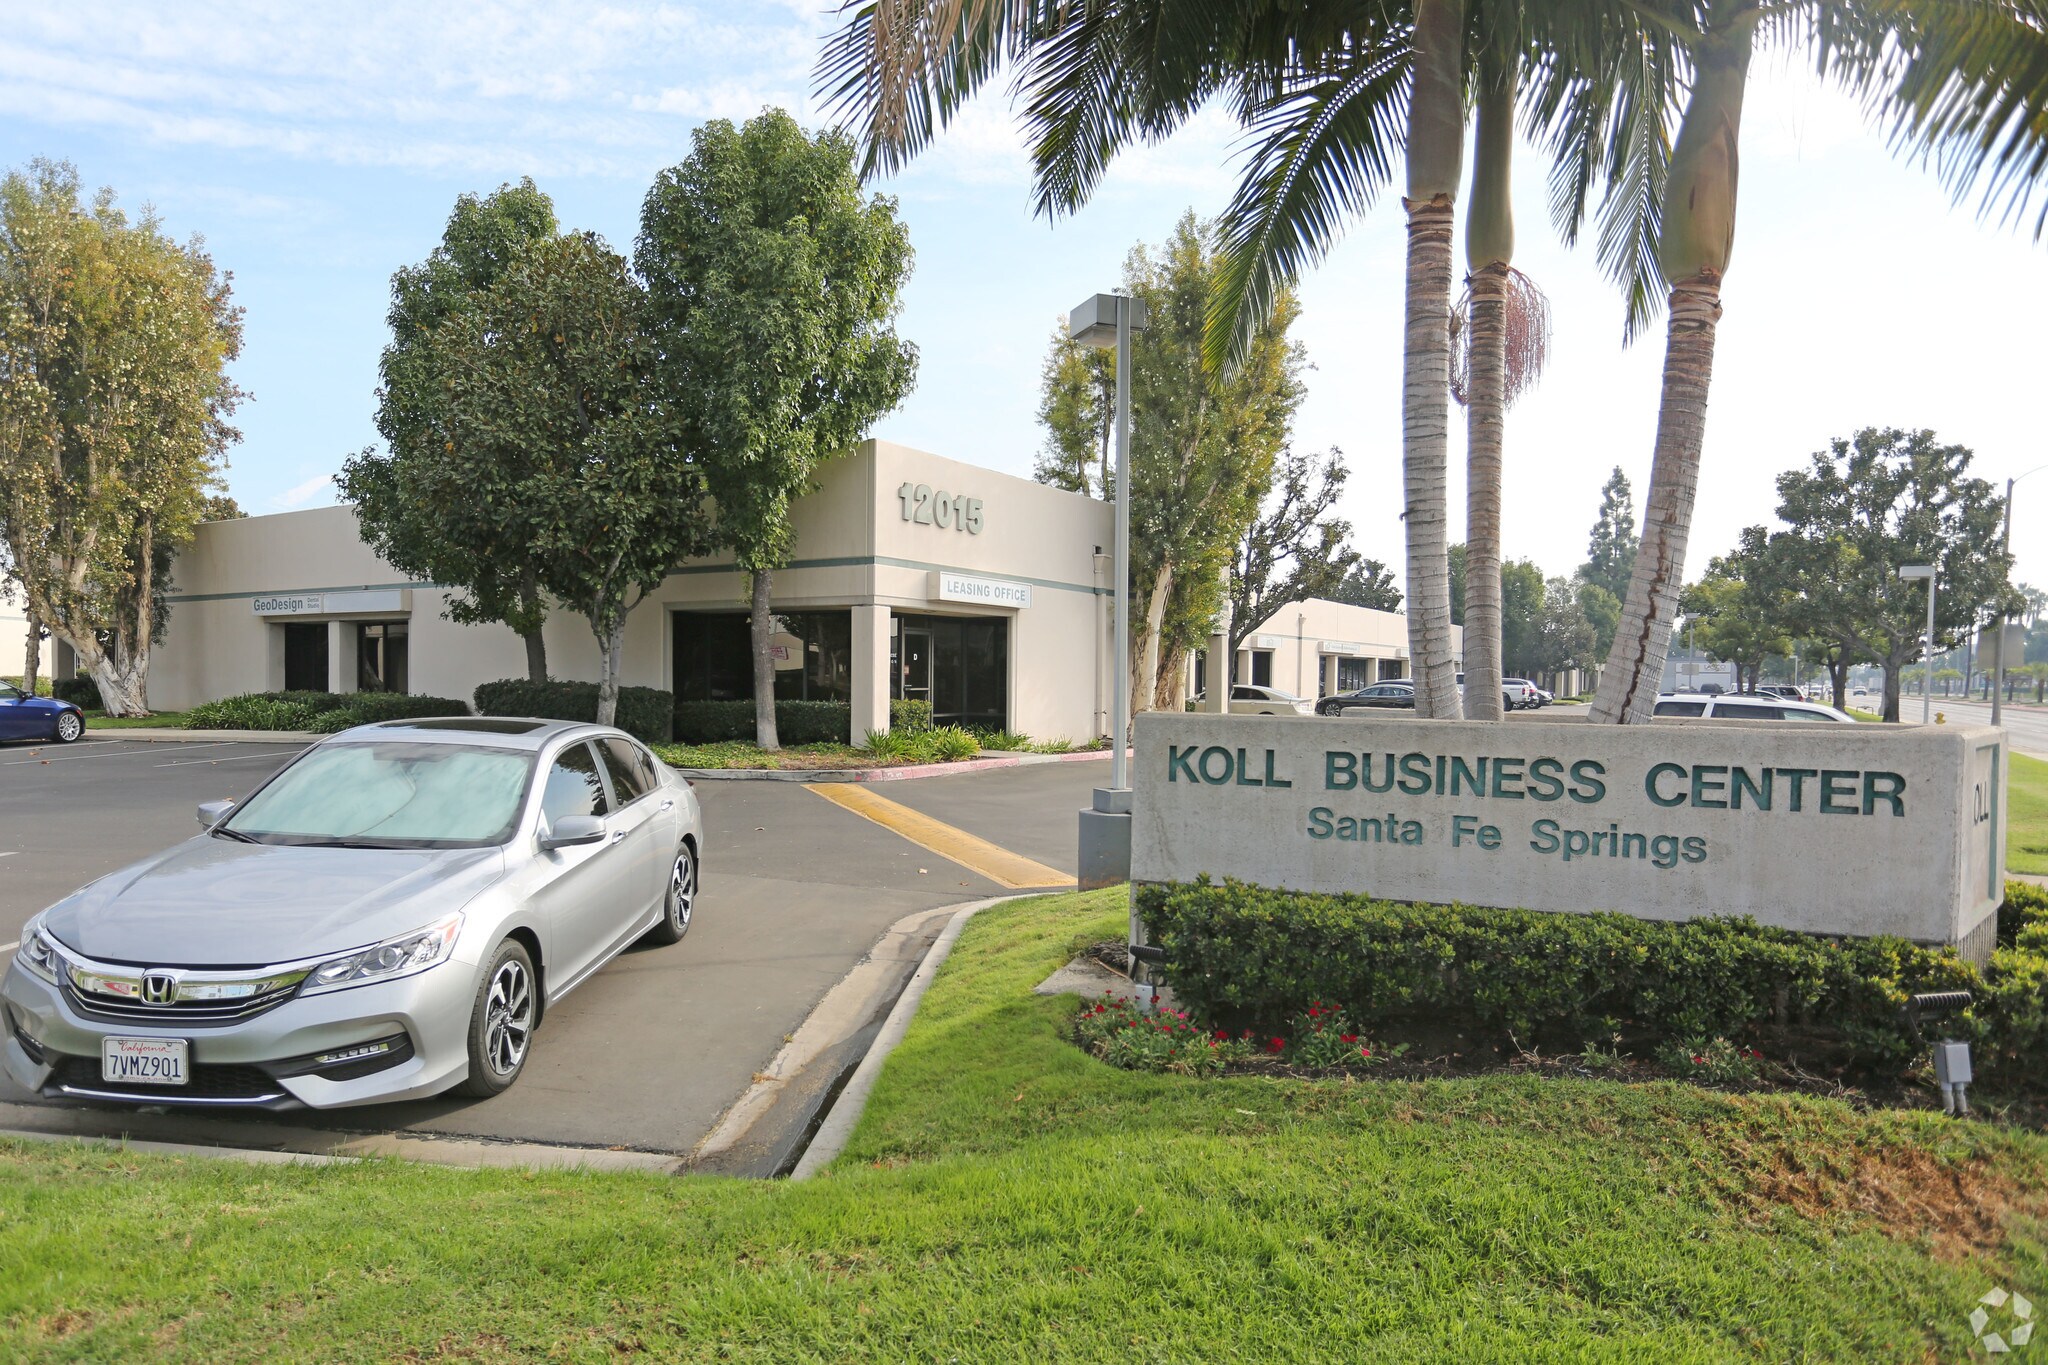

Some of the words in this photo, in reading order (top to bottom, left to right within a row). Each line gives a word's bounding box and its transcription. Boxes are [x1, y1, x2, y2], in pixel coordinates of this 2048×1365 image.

[898, 482, 984, 535] 12015
[947, 580, 990, 597] LEASING
[994, 586, 1026, 602] OFFICE
[254, 598, 303, 612] GeoDesign
[1168, 745, 1292, 788] KOLL
[1325, 751, 1607, 803] BUSINESS
[1644, 763, 1907, 818] CENTER
[1307, 807, 1423, 846] Santa
[1451, 812, 1501, 851] Fe
[1530, 819, 1708, 869] Springs
[121, 1041, 170, 1054] California
[110, 1055, 181, 1077] 7VMZ901
